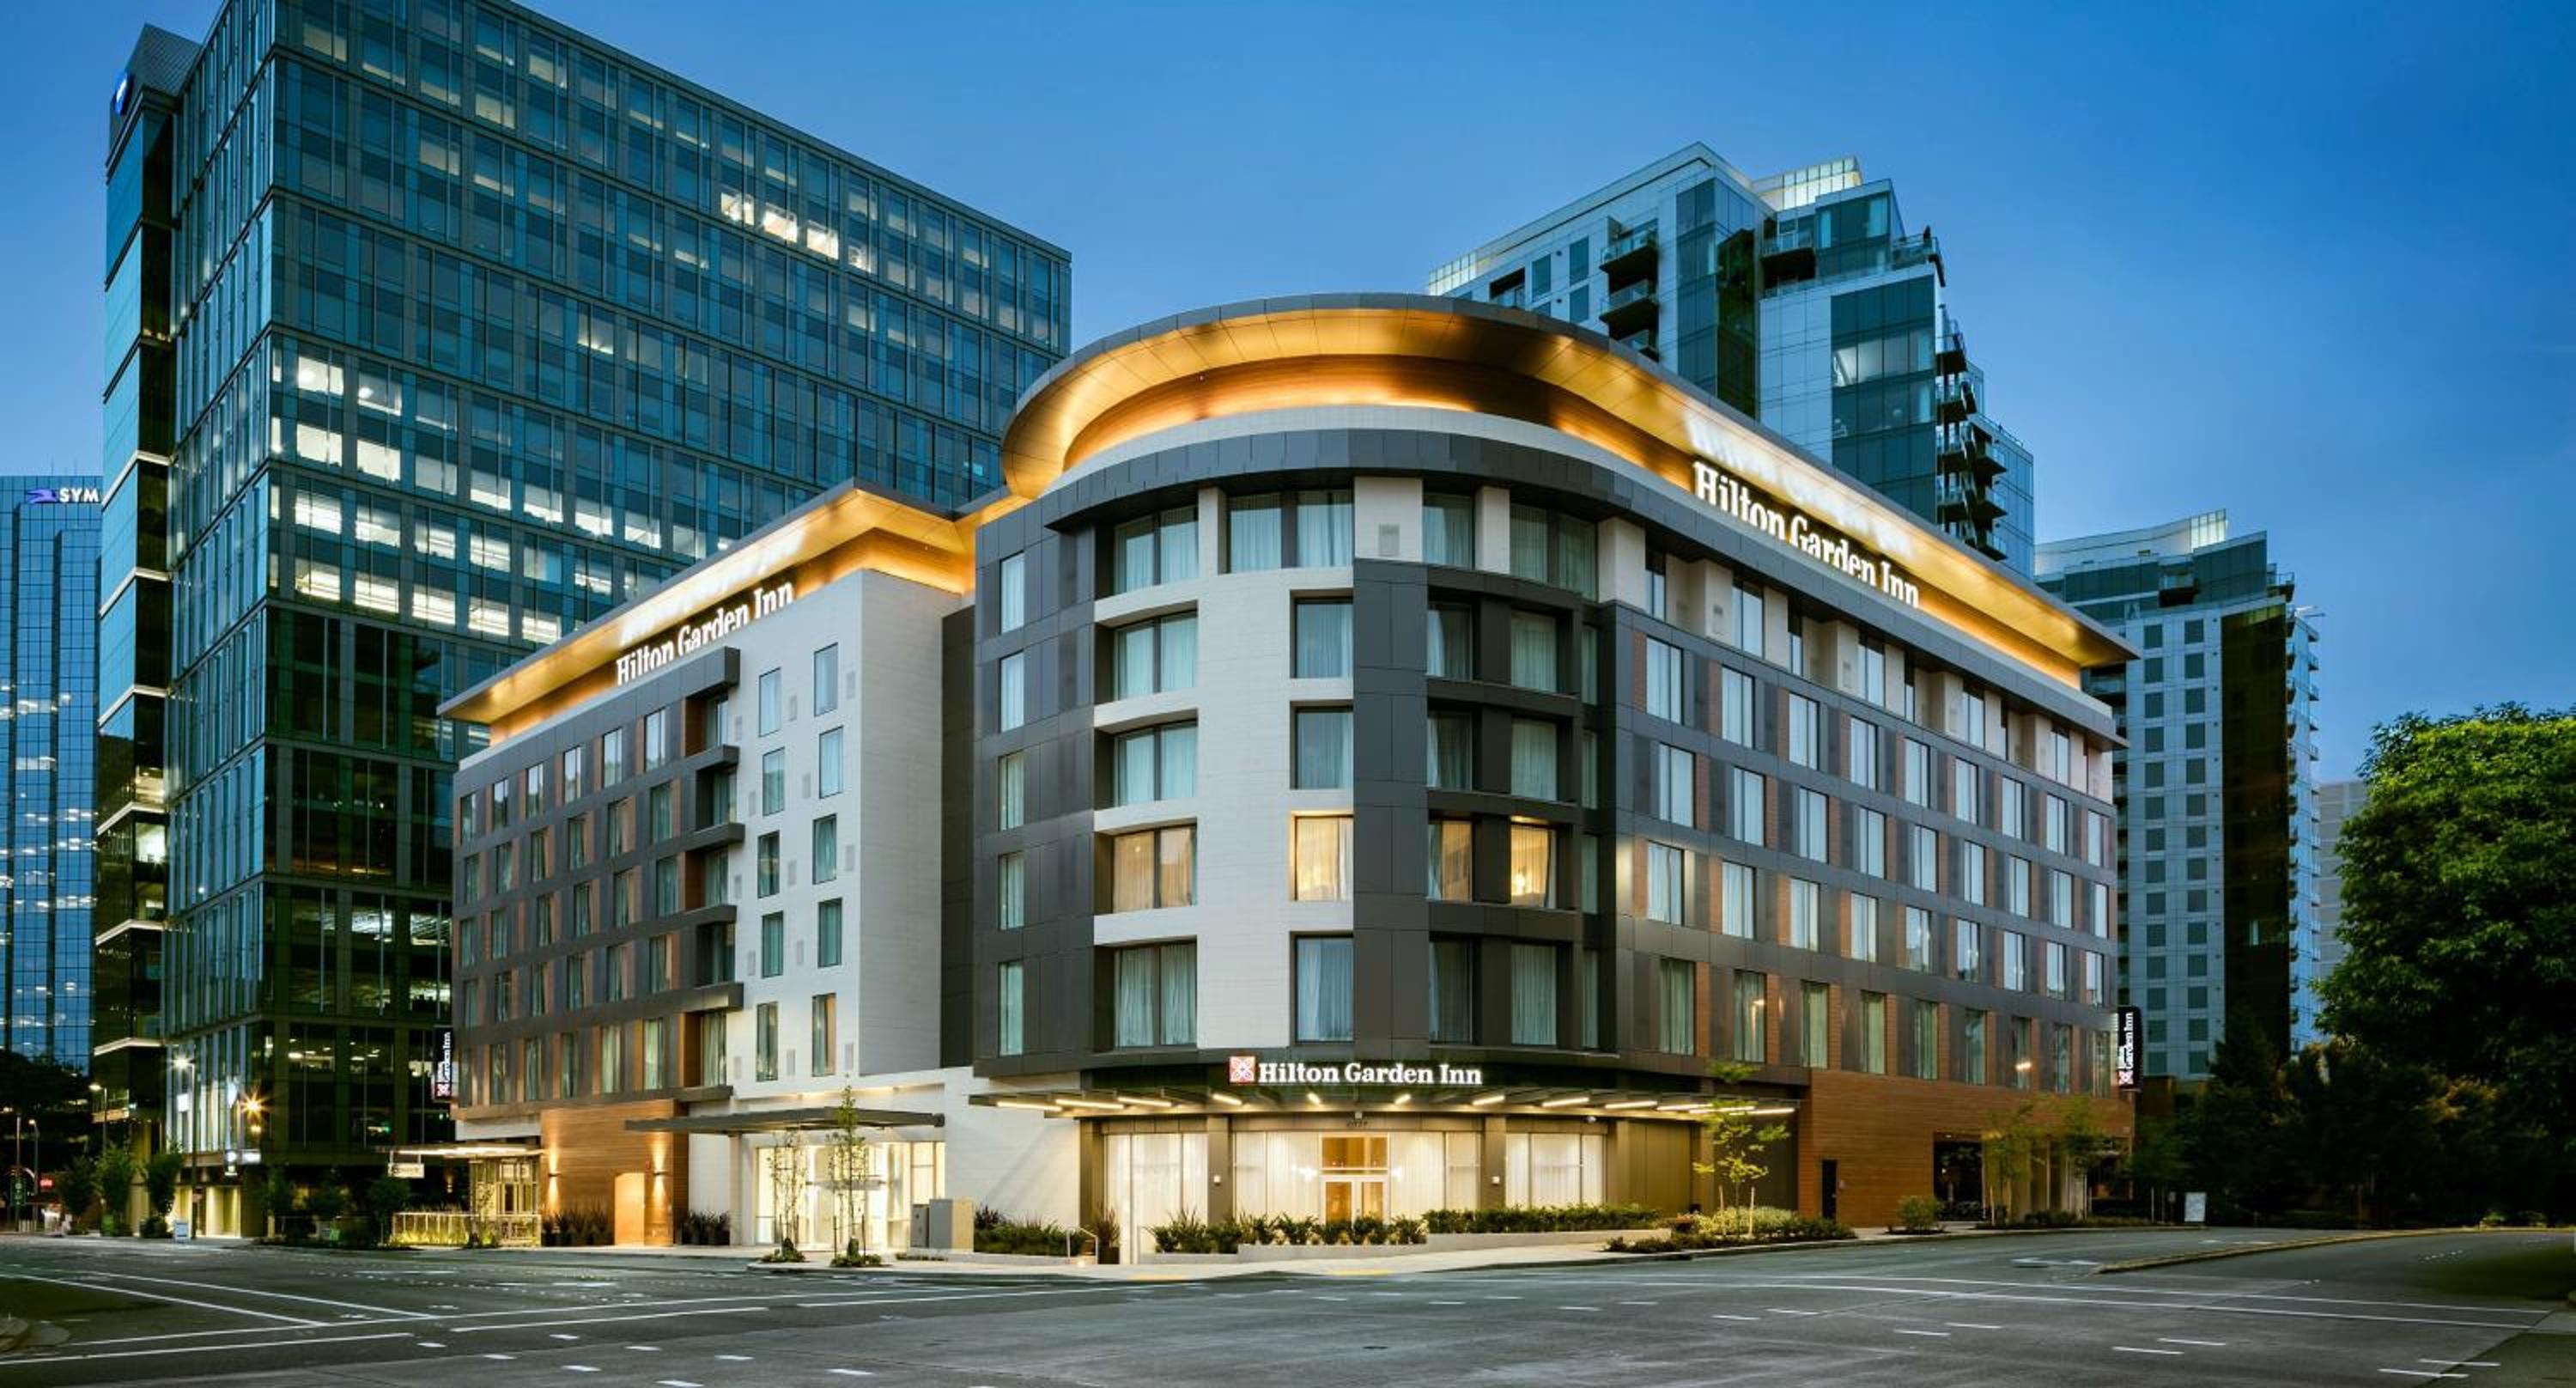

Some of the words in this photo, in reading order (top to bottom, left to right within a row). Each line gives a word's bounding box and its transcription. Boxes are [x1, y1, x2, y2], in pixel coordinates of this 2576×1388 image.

[1692, 461, 1785, 540] Hilton
[1789, 514, 1876, 587] Garden
[1880, 560, 1919, 608] Inn
[617, 638, 674, 685] Hilton
[677, 602, 750, 656] Garden
[754, 581, 795, 618] Inn
[1258, 1062, 1340, 1084] Hilton
[1344, 1063, 1434, 1085] Garden
[1439, 1063, 1483, 1086] Inn
